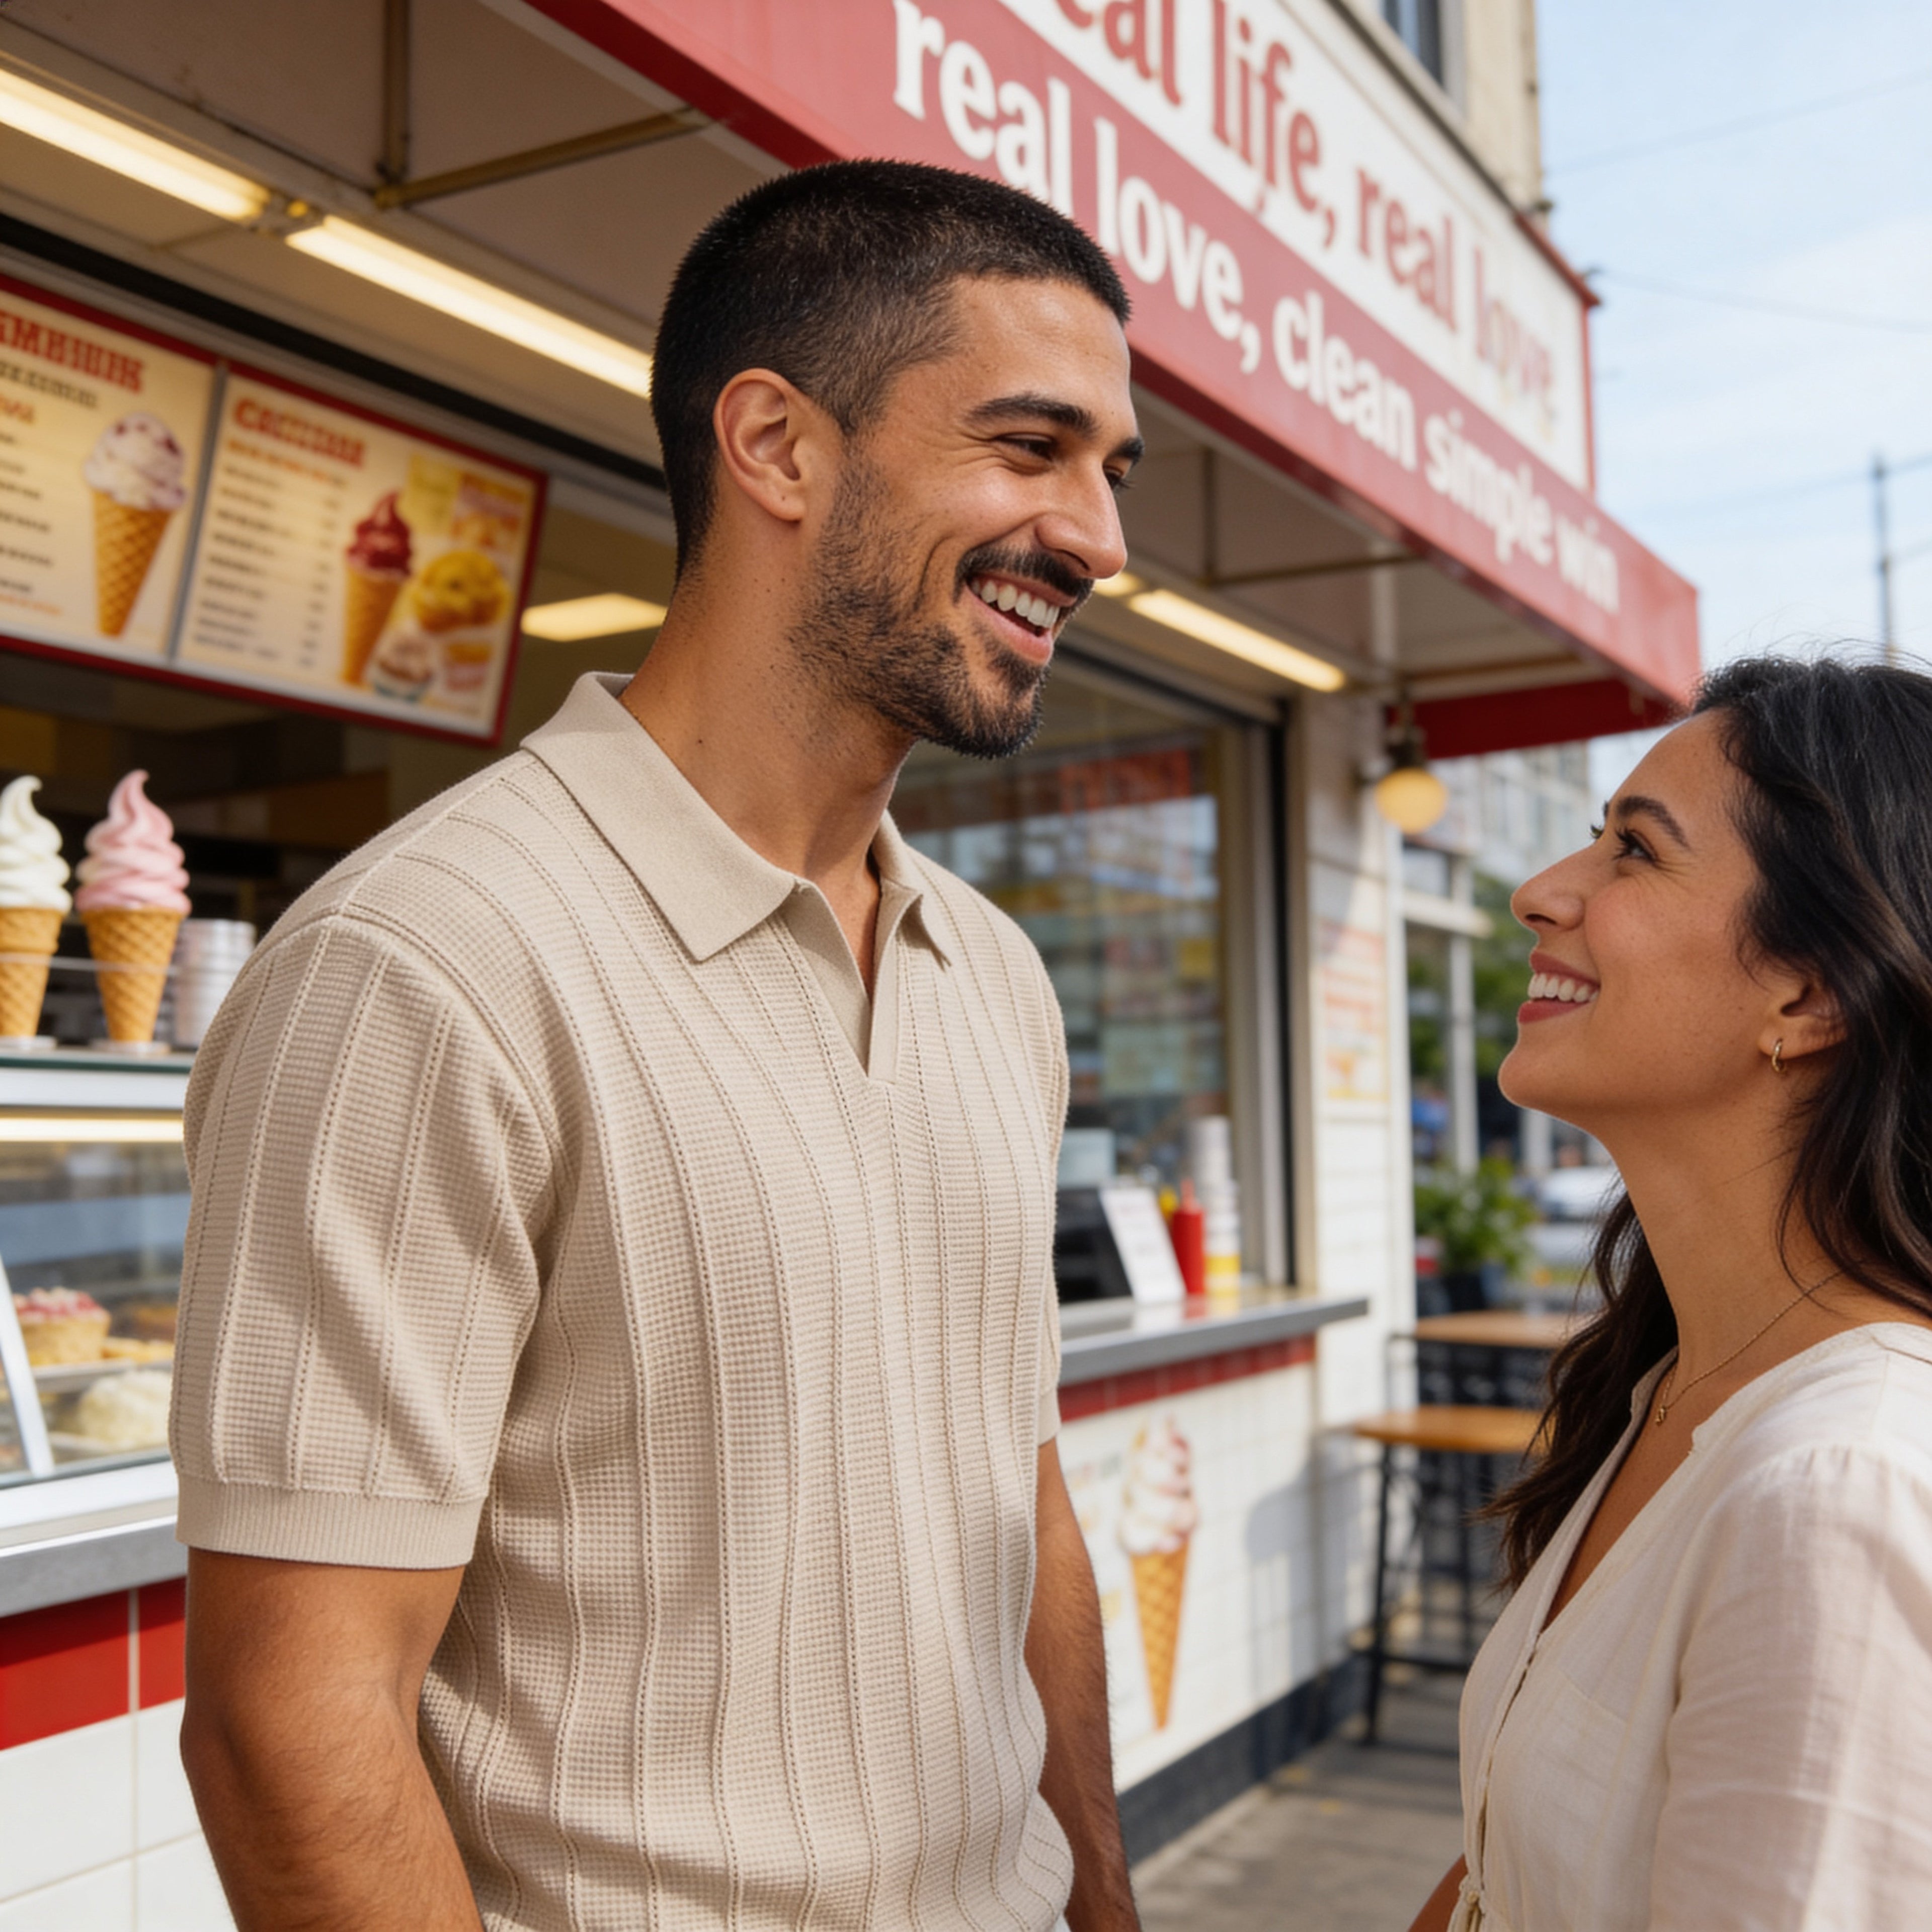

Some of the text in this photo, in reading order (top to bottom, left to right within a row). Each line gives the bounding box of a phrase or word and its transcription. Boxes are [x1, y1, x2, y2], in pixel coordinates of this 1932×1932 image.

[893, 0, 1073, 219] real
[1095, 116, 1261, 374] love,
[1272, 290, 1416, 472] clean
[1423, 406, 1554, 566] simple
[1212, 0, 1336, 250] life,
[1357, 166, 1457, 334] real
